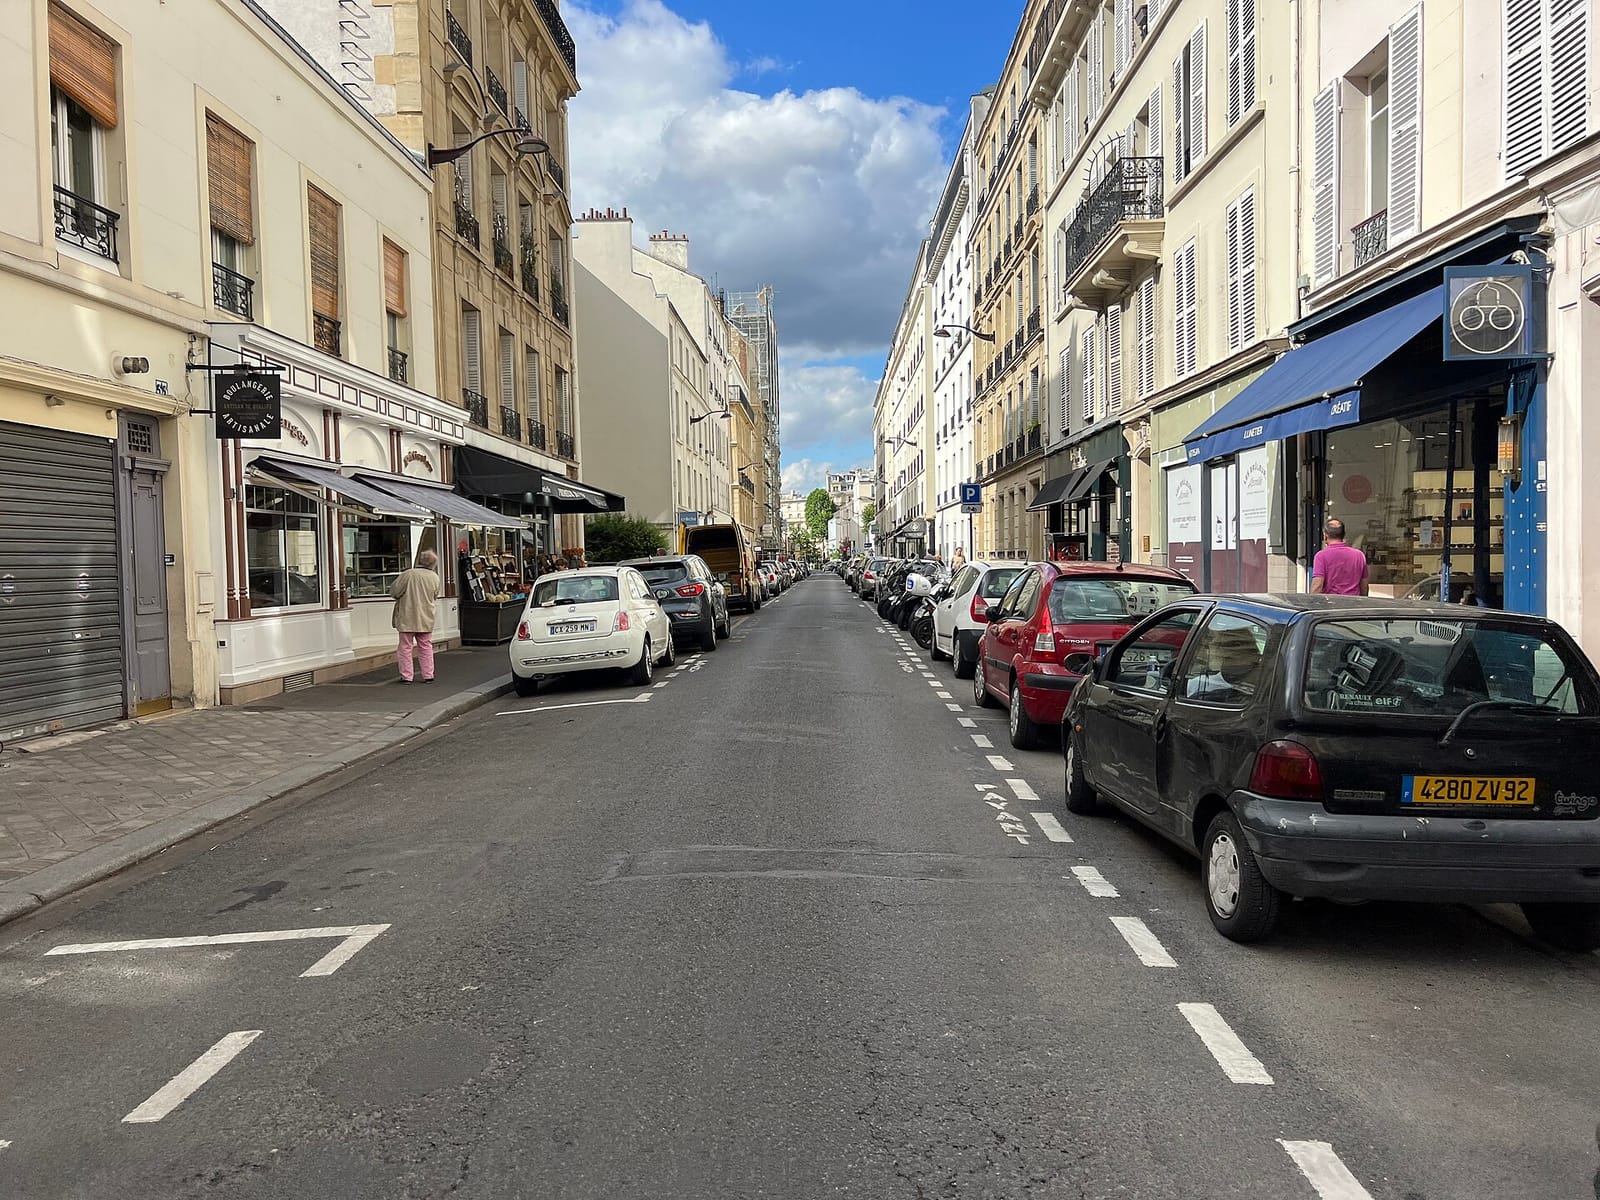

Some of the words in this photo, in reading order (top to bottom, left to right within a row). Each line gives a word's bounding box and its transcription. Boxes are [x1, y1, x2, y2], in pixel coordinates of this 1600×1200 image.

[222, 380, 274, 401] BOULANGERIE
[222, 413, 274, 433] ARTISANALE
[966, 487, 976, 501] P
[1339, 693, 1373, 701] RENAULT
[1420, 779, 1472, 800] 4280
[1475, 779, 1500, 801] ZV
[1504, 780, 1530, 801] 92
[1554, 789, 1598, 812] twingo
